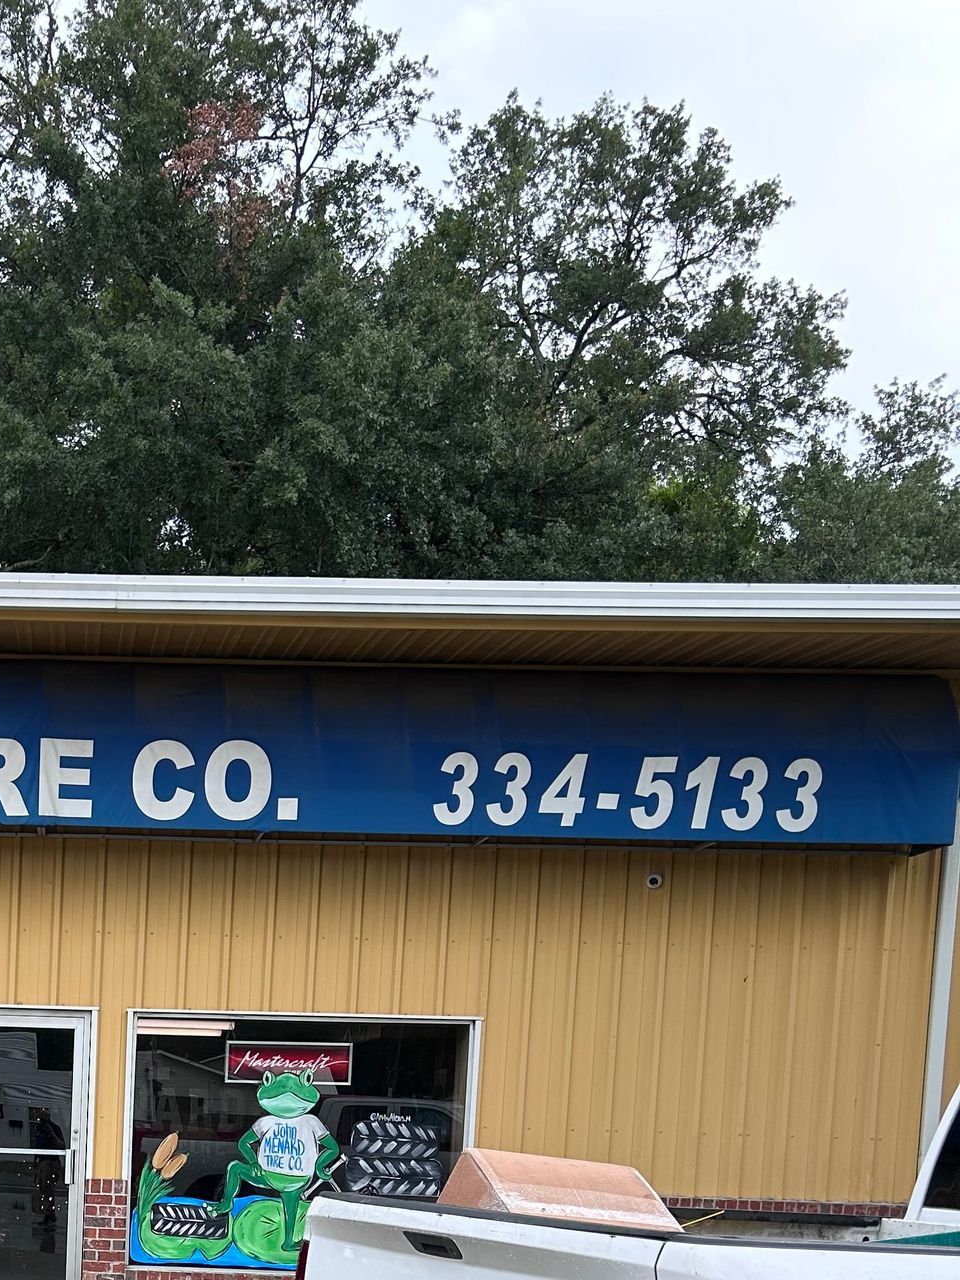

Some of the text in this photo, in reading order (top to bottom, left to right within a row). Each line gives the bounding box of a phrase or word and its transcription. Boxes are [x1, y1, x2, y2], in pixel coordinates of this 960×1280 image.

[132, 739, 299, 821] CO.
[433, 751, 823, 833] 334-5133
[233, 1050, 348, 1075] Mastercraft
[273, 1122, 297, 1140] John
[263, 1136, 305, 1156] MENARD
[263, 1155, 304, 1172] TIRE CO.
